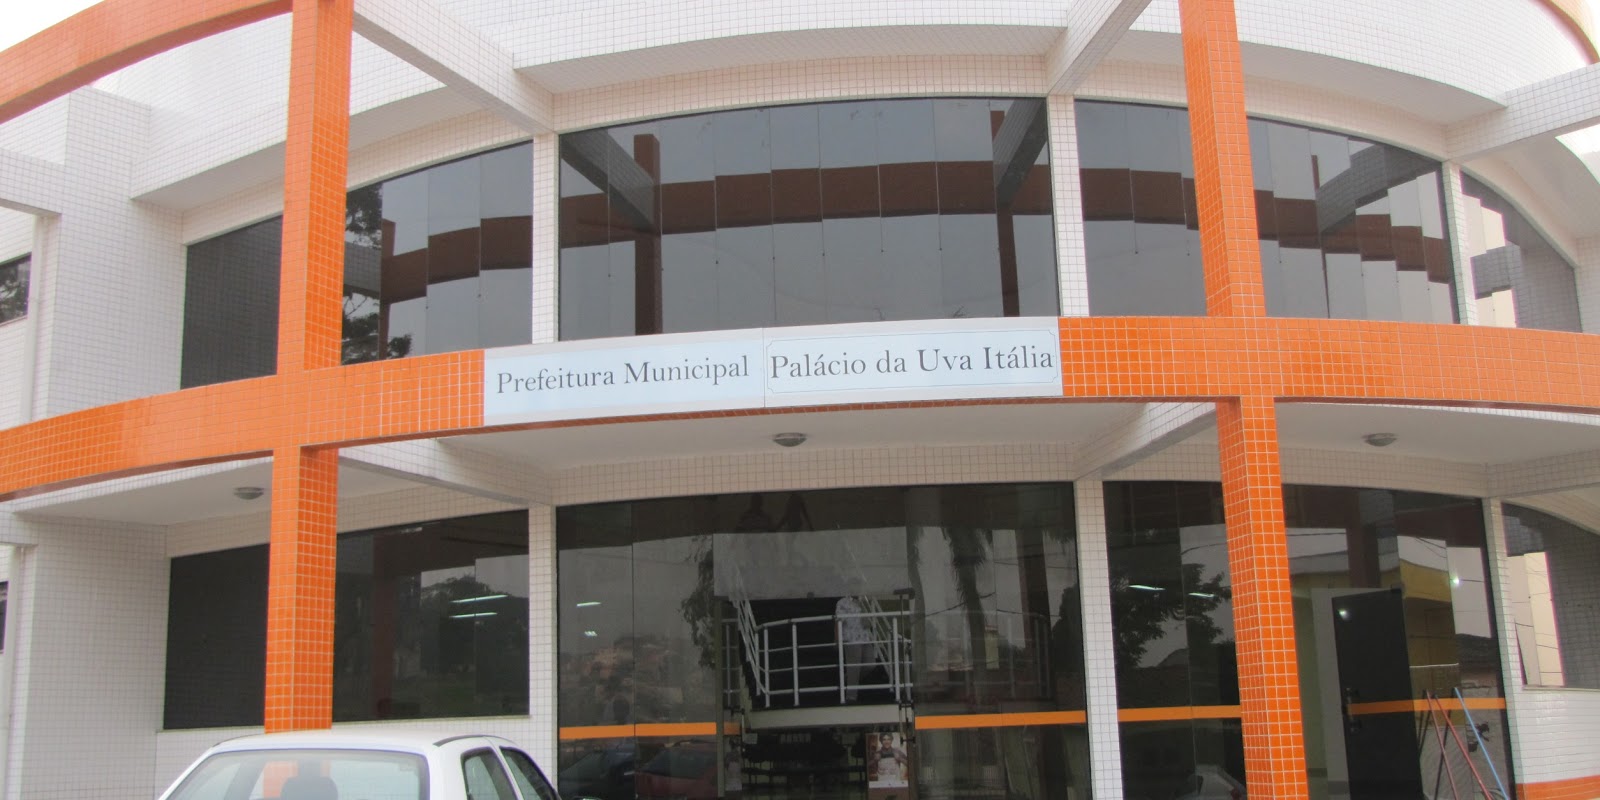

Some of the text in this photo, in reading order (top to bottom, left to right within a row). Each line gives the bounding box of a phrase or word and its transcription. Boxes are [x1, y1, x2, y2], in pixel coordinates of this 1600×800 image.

[497, 355, 750, 394] Prefeitura Municipal
[770, 345, 1054, 379] Palácio da Uva Itália
